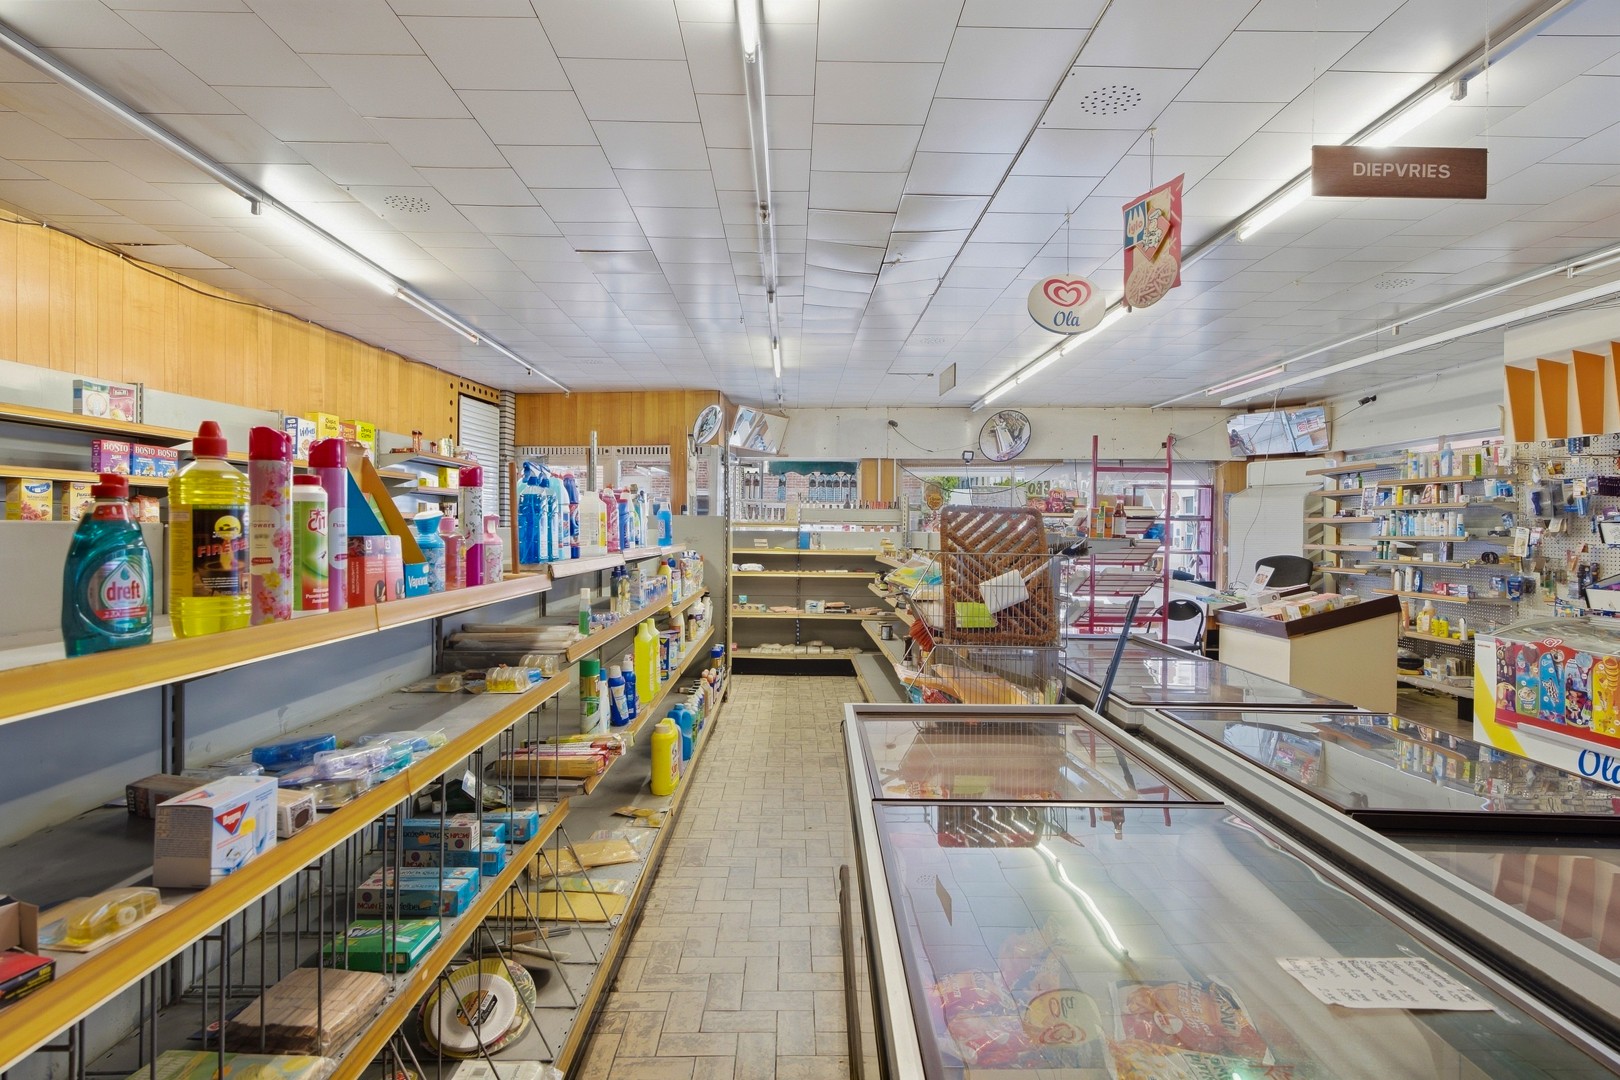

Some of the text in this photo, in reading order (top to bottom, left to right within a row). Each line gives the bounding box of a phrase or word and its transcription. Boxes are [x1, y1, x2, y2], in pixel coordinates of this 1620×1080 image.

[1352, 161, 1451, 180] DIEPVRIES
[1053, 310, 1080, 328] Ola
[103, 442, 129, 453] BOSTO
[135, 446, 155, 456] BOSTO
[157, 449, 178, 458] BOSTO
[106, 580, 141, 601] dreft
